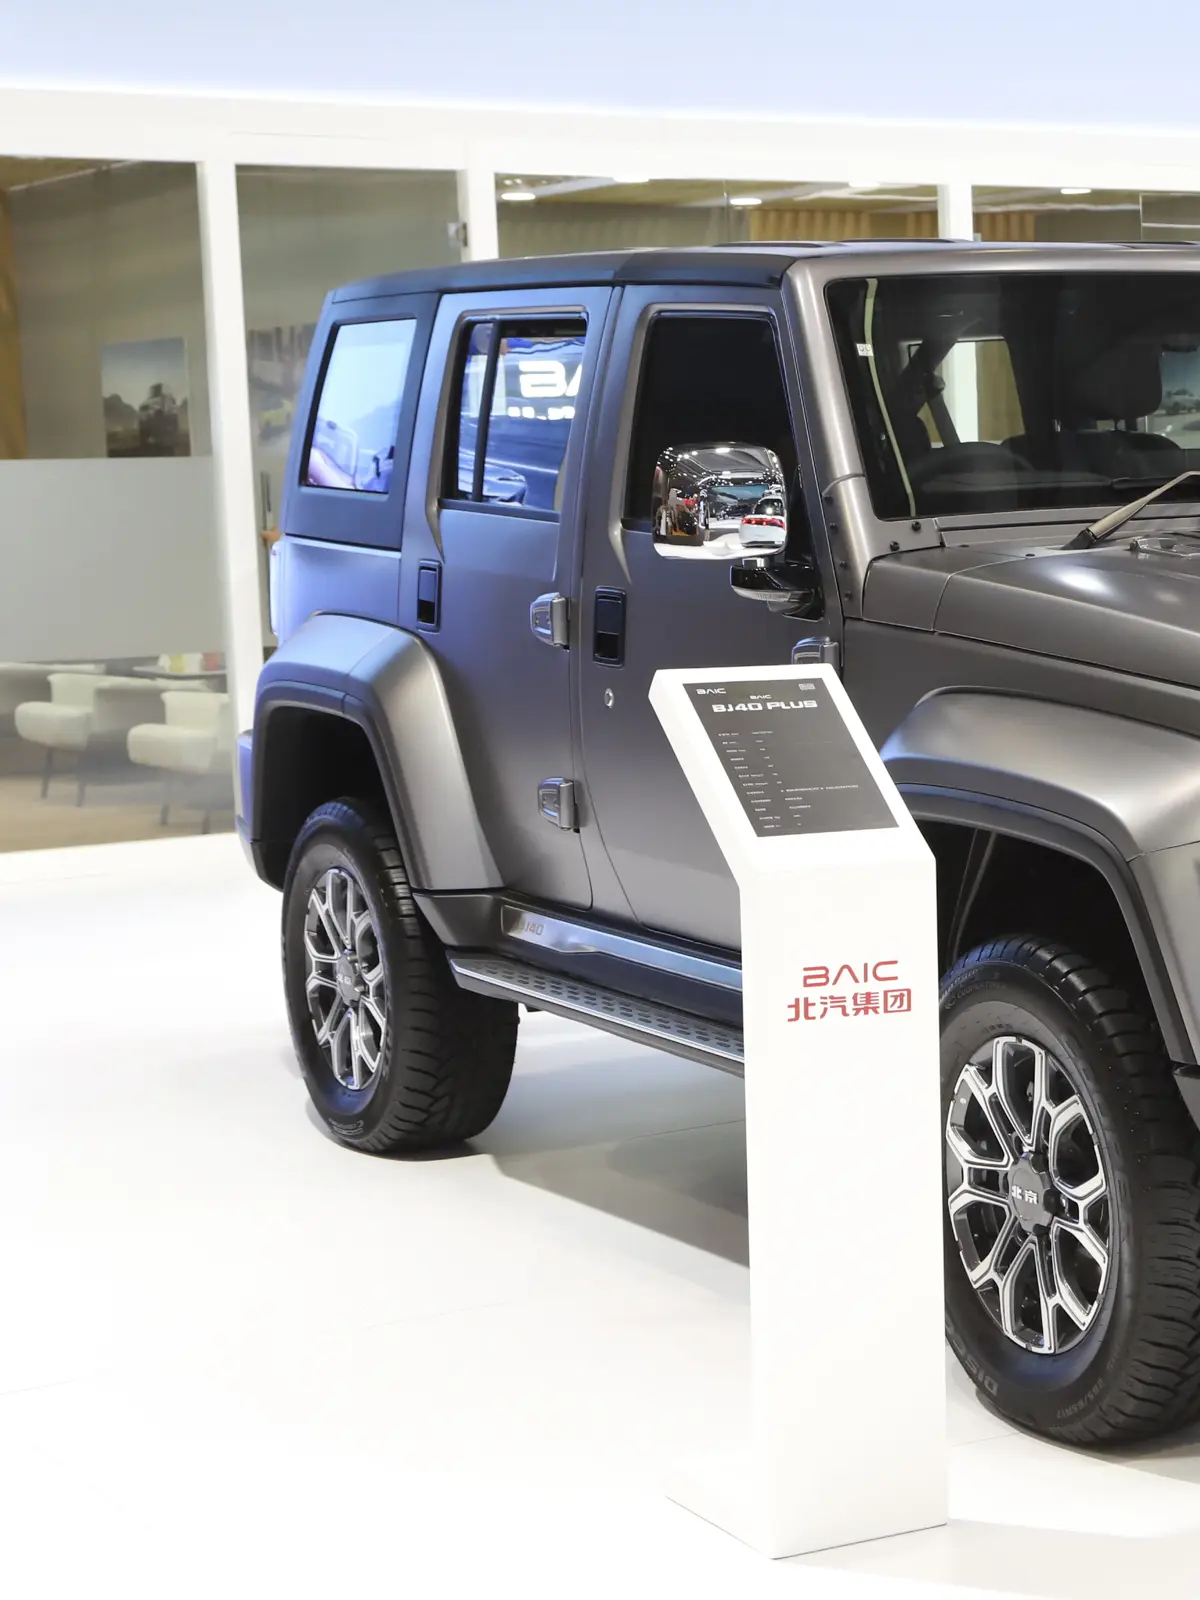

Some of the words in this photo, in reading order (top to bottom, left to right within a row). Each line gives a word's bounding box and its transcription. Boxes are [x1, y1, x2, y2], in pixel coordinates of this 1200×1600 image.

[696, 687, 727, 695] BAIC
[712, 702, 763, 713] BJ40
[766, 700, 818, 710] PLUS
[517, 920, 545, 936] J40
[803, 960, 898, 988] BAIC
[787, 988, 911, 1022] 北汽集团
[1011, 1185, 1038, 1204] 北京
